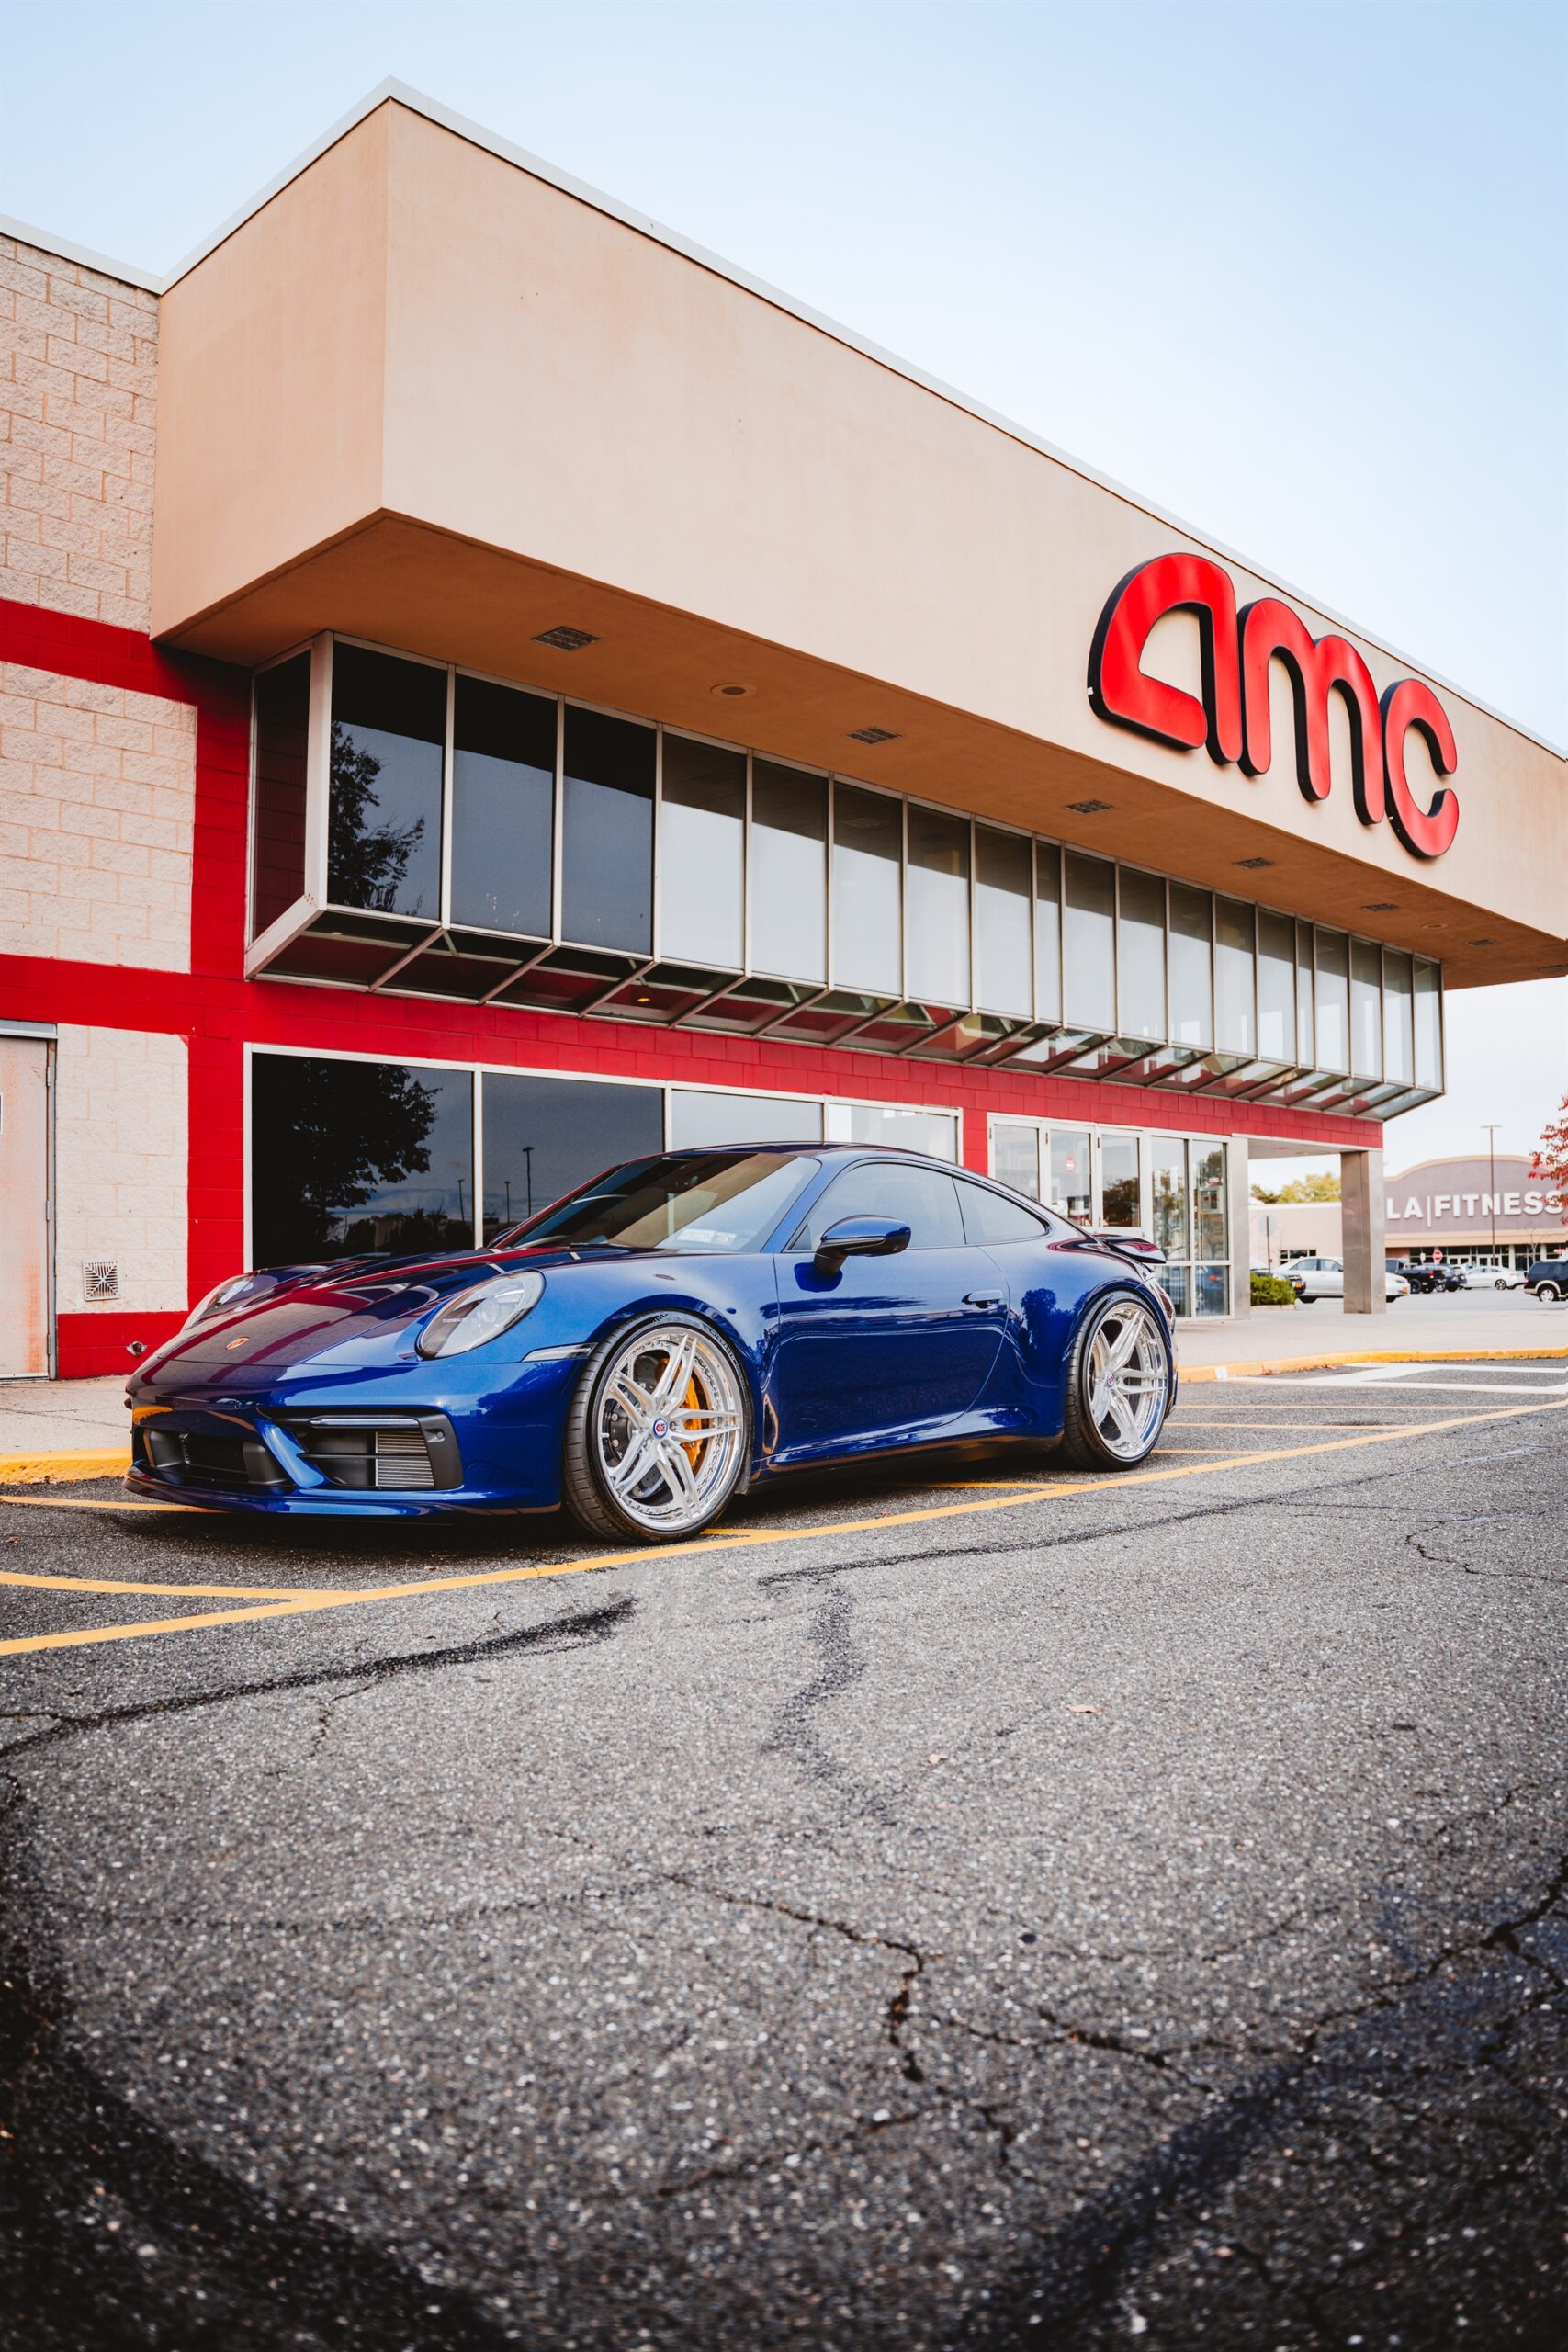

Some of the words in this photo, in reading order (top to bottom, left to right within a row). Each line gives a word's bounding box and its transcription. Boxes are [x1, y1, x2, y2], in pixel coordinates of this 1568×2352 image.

[1087, 552, 1459, 858] amc
[1386, 1197, 1424, 1219] LA
[1434, 1190, 1564, 1217] FITNESS
